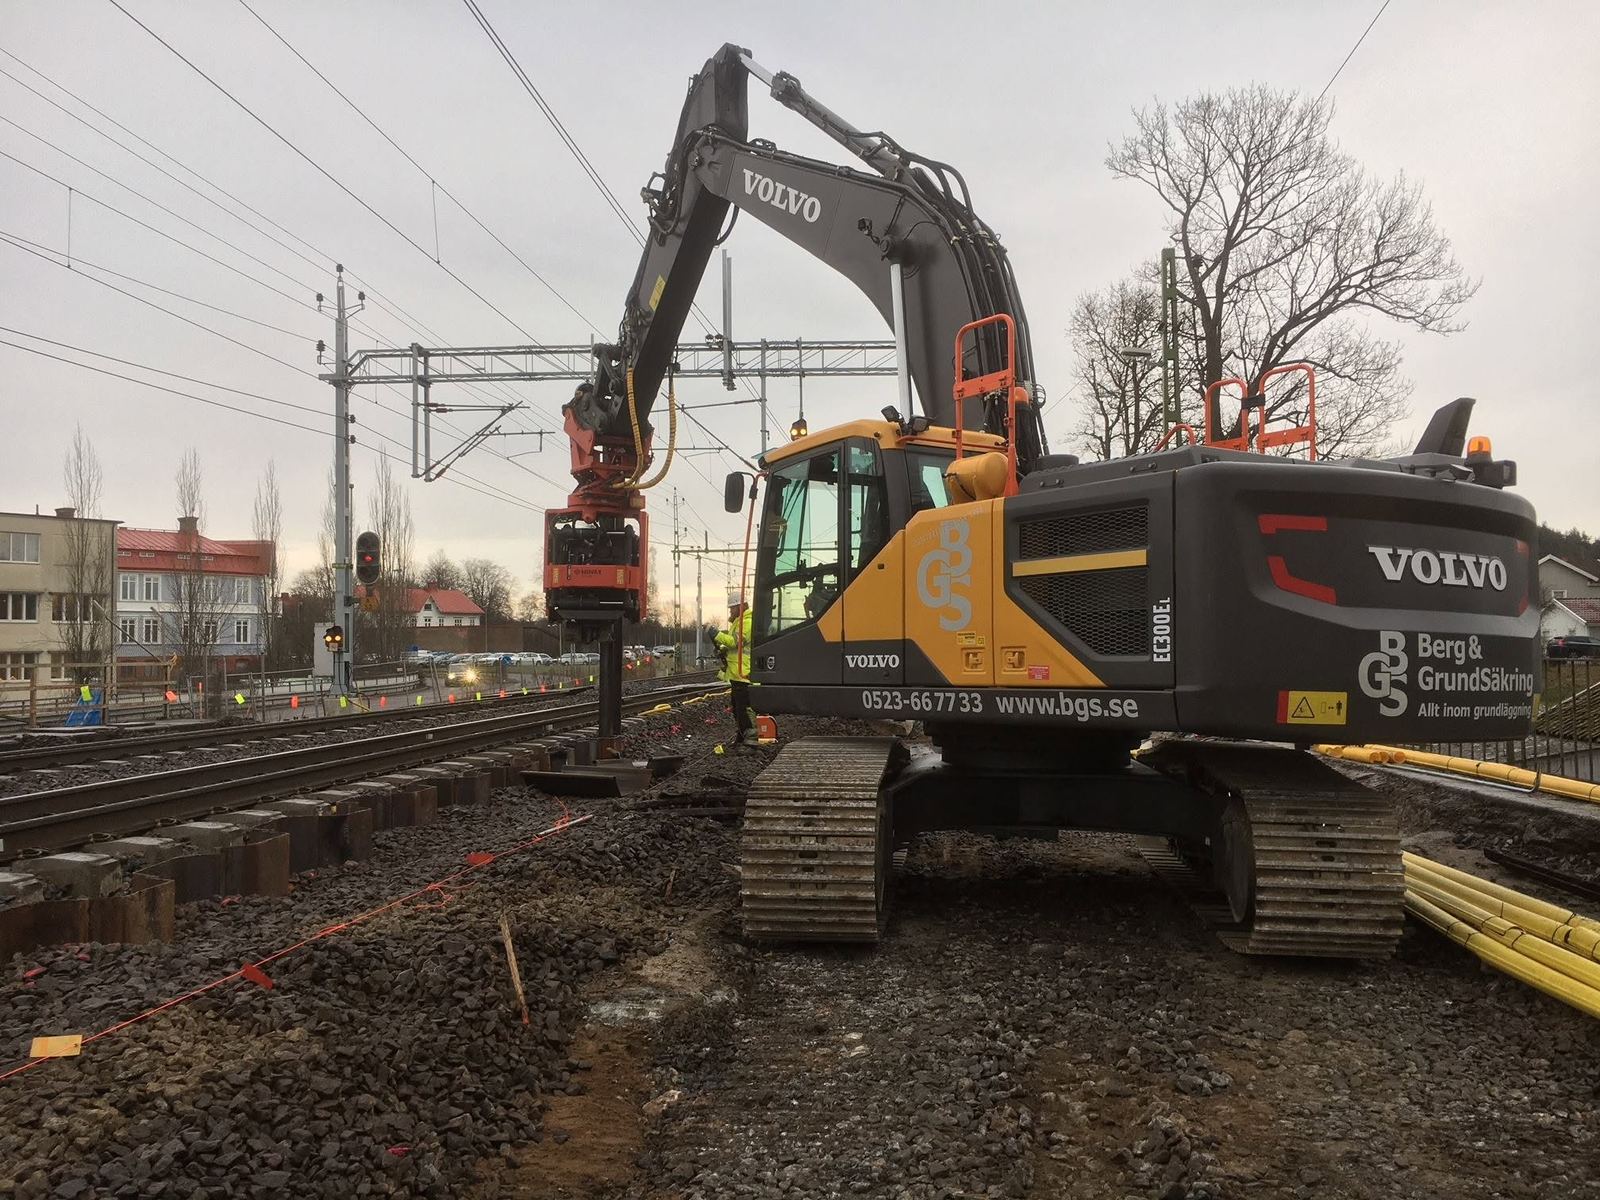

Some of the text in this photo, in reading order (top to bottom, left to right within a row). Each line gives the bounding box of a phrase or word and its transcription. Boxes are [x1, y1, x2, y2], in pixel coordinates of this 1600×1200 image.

[743, 168, 821, 223] VOLVO
[1368, 546, 1507, 591] VOLVO
[845, 654, 900, 668] VOLVO
[1418, 633, 1483, 665] Berg &
[1417, 665, 1534, 697] GrundSäkring
[995, 691, 1139, 722] www.bgs.se
[1418, 702, 1532, 720] Allt inom grundläggning
